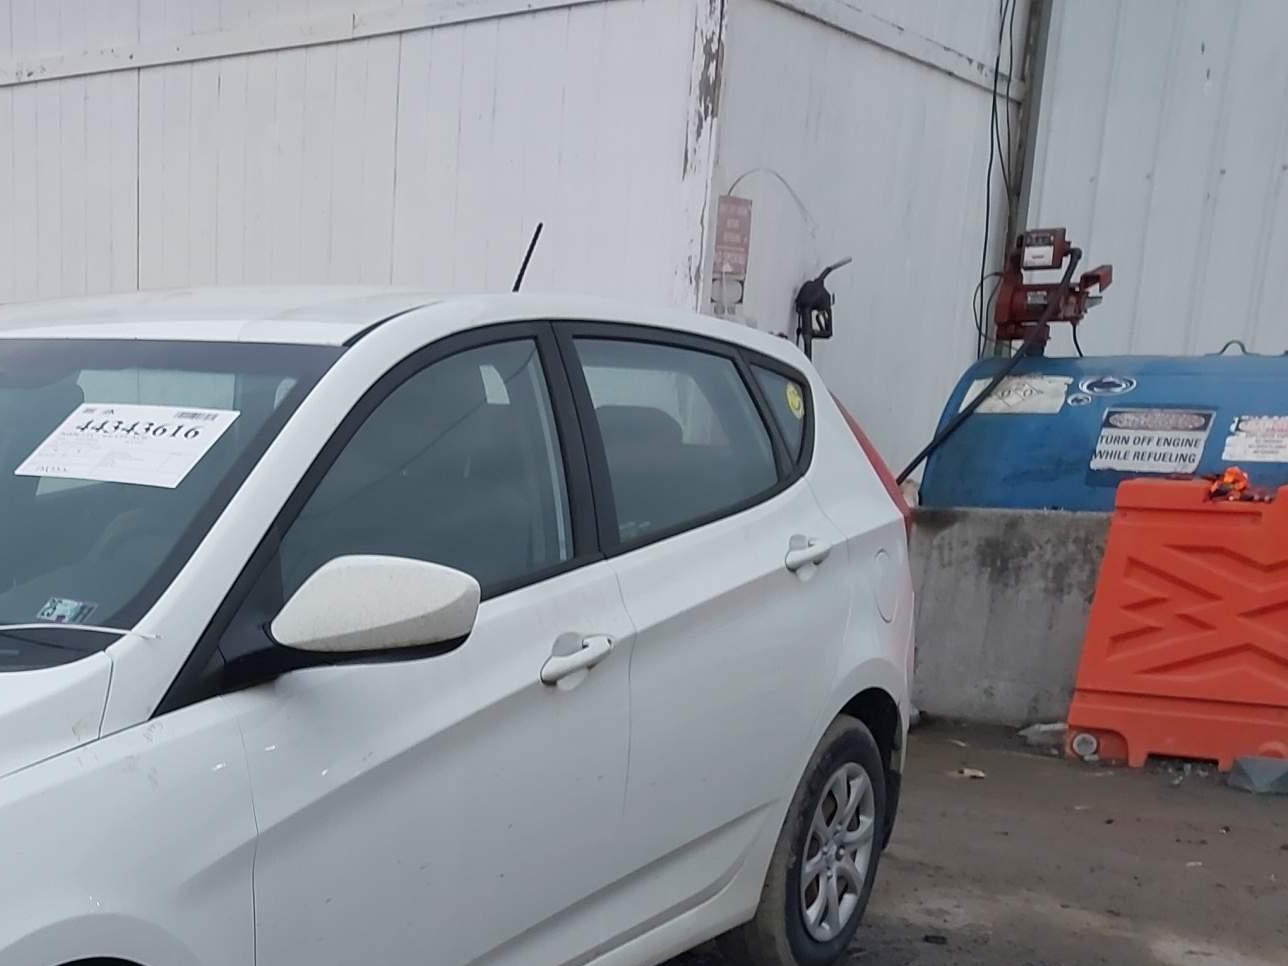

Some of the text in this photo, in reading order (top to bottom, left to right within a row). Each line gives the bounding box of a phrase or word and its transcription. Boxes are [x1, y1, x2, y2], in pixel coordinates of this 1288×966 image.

[75, 418, 202, 440] 44343616
[1099, 434, 1202, 449] TURN OFF ENGINE
[1095, 450, 1197, 464] WHILE REFUELING
